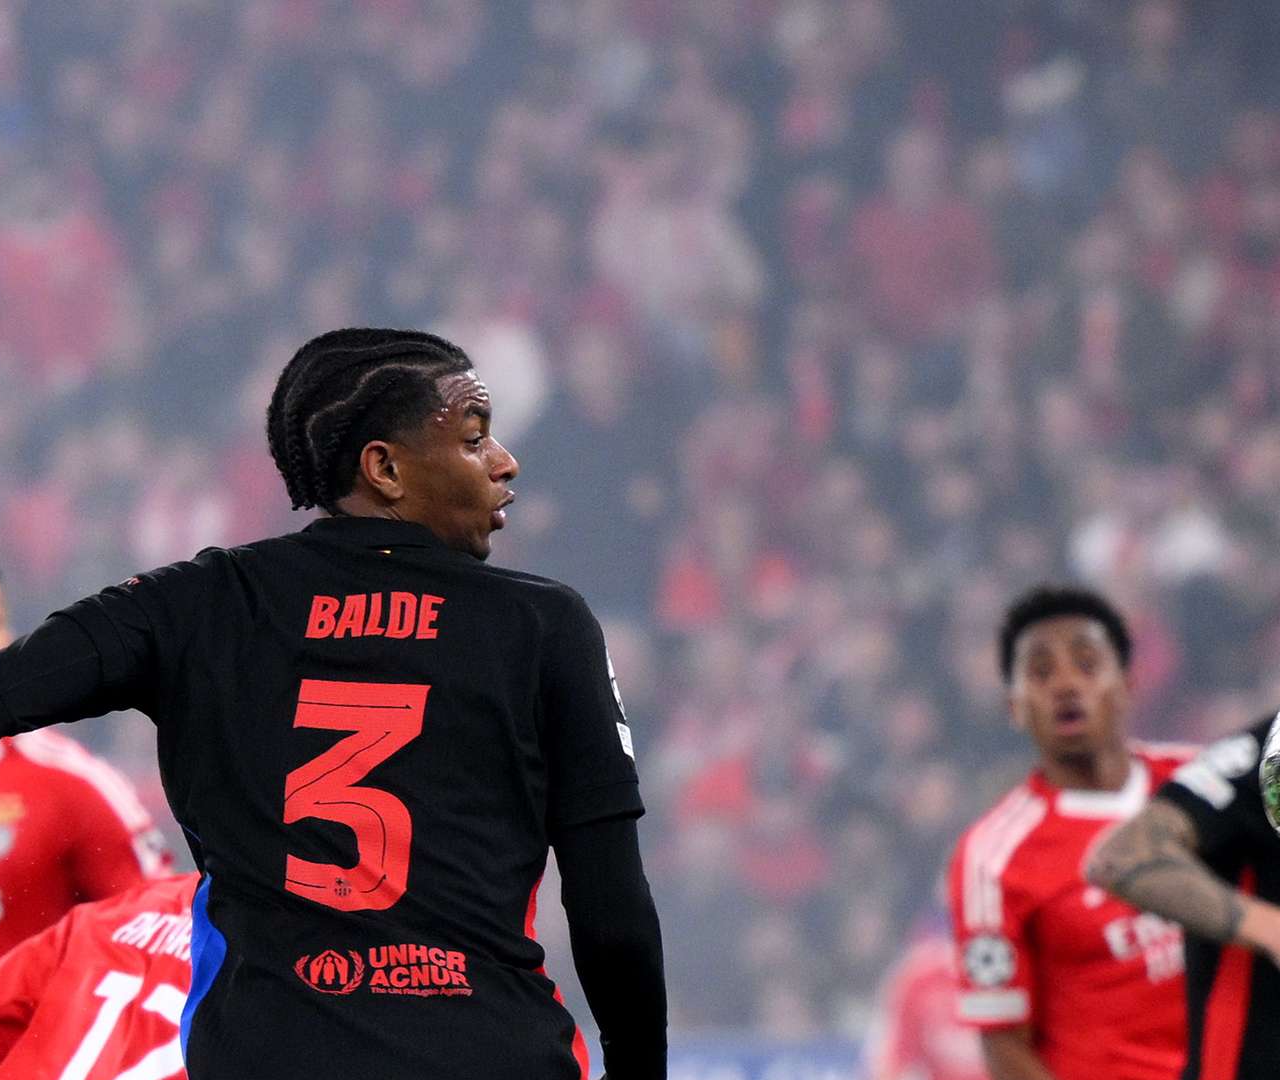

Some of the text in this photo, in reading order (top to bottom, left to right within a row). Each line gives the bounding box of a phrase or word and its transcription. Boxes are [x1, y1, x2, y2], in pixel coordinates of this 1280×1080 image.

[304, 591, 446, 640] BALDE
[282, 678, 432, 912] 3
[368, 943, 467, 973] UNHCR
[368, 964, 471, 988] ACNUR
